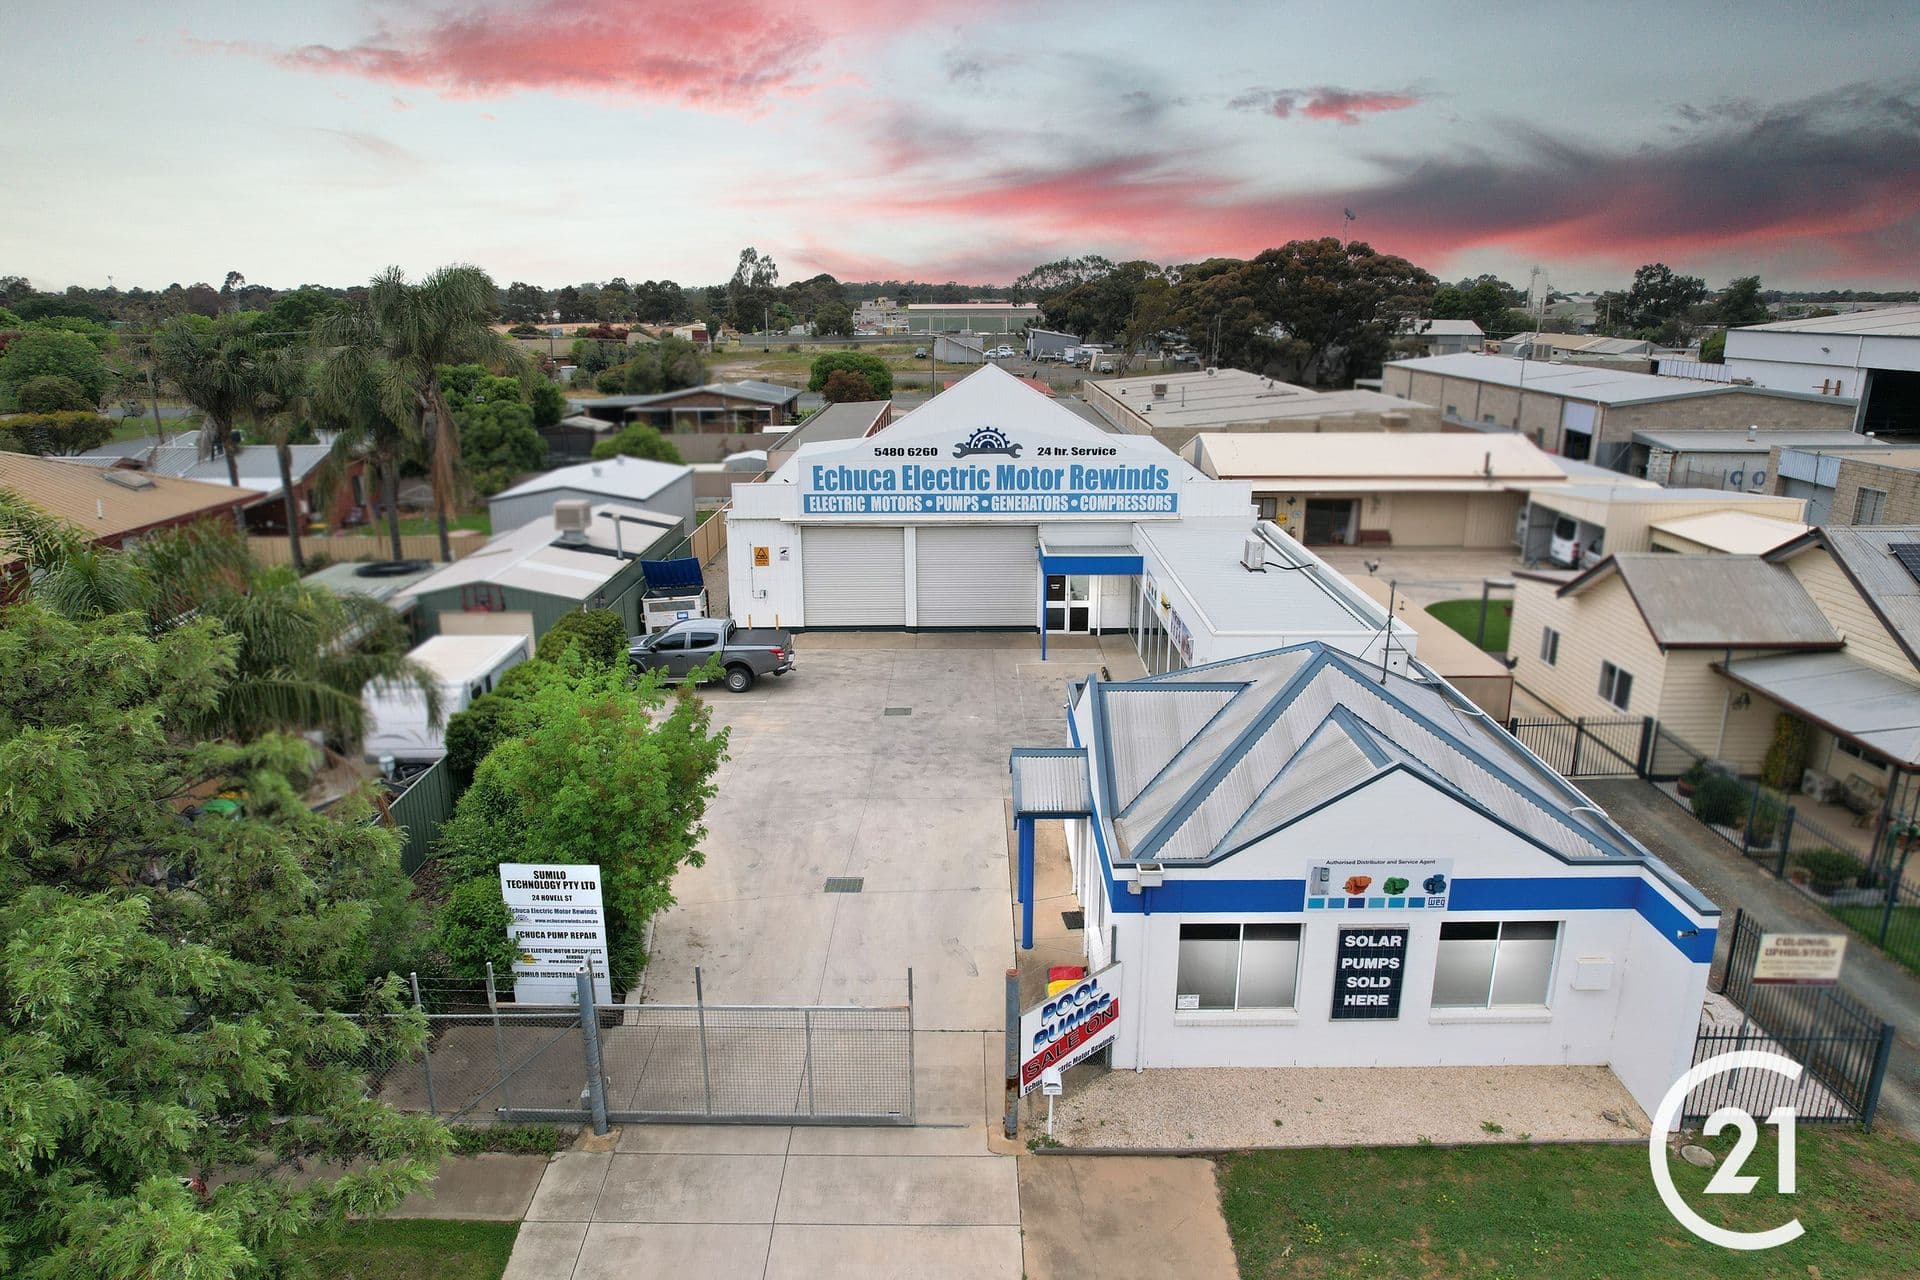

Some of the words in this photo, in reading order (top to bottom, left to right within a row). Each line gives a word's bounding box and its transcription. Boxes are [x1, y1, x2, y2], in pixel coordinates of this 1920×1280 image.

[874, 447, 905, 457] 5480
[907, 447, 938, 457] 6260
[1037, 447, 1051, 456] 24
[1054, 447, 1068, 456] hr.
[1071, 446, 1117, 456] Service
[812, 465, 896, 491] Echuca
[902, 465, 990, 491] Electric
[996, 464, 1064, 491] Motor
[1069, 464, 1169, 491] Rewinds
[809, 495, 866, 512] ELECTRIC
[870, 495, 923, 512] MOTORS
[935, 495, 980, 512] PUMPS
[991, 495, 1069, 511] GENERATORS
[1079, 495, 1172, 511] COMPRESSORS
[533, 870, 566, 880] SUMILO
[506, 879, 561, 890] TECHNOLOGY
[563, 881, 580, 890] PTY
[581, 881, 596, 890] LTD
[547, 931, 568, 939] PUMP
[570, 931, 597, 940] REPAIR
[1344, 935, 1402, 947] SOLAR
[1341, 957, 1400, 970] PUMPS
[1346, 976, 1391, 988] SOLD
[1041, 978, 1103, 1027] POOL
[1343, 994, 1389, 1006] HERE
[1033, 992, 1111, 1054] PUMPS
[1027, 1030, 1081, 1078] SALE
[1085, 1004, 1115, 1034] ON
[1072, 1050, 1090, 1066] Motor
[1090, 1034, 1116, 1053] Rewinds
